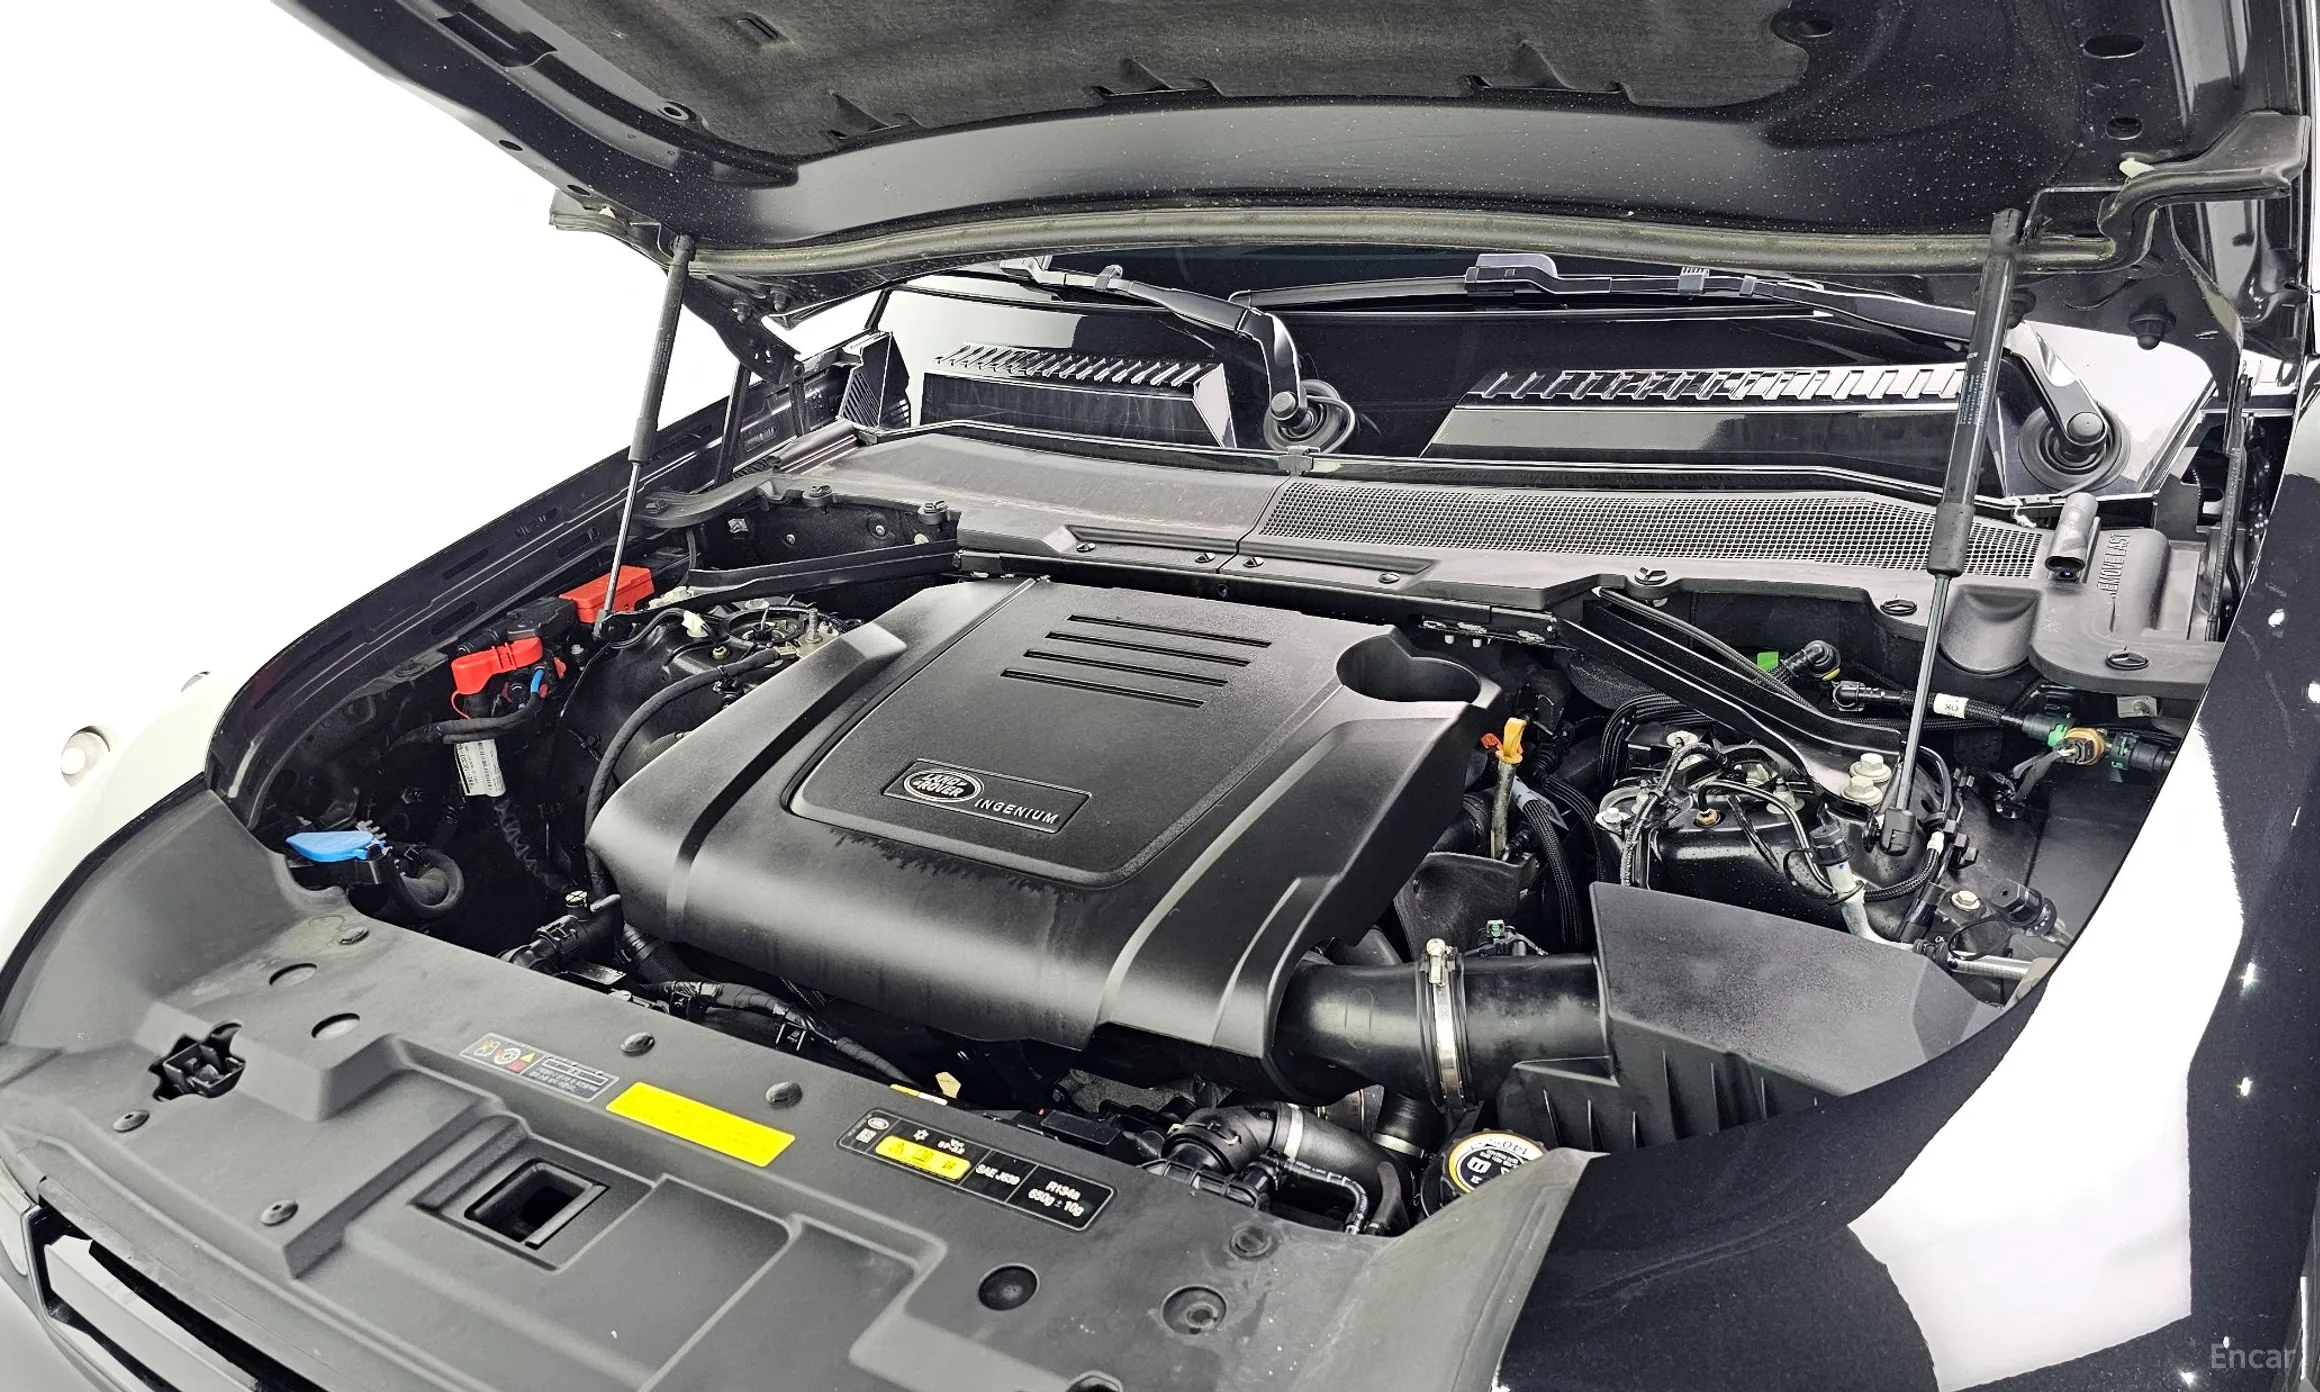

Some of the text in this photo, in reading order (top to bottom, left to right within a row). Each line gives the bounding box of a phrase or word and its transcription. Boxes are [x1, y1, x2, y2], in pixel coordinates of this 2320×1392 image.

[916, 781, 965, 798] ROVER
[974, 798, 1059, 825] INGENIUM
[975, 1163, 999, 1179] SAE
[1045, 1180, 1081, 1201] R134a
[1064, 1200, 1085, 1217] 10g
